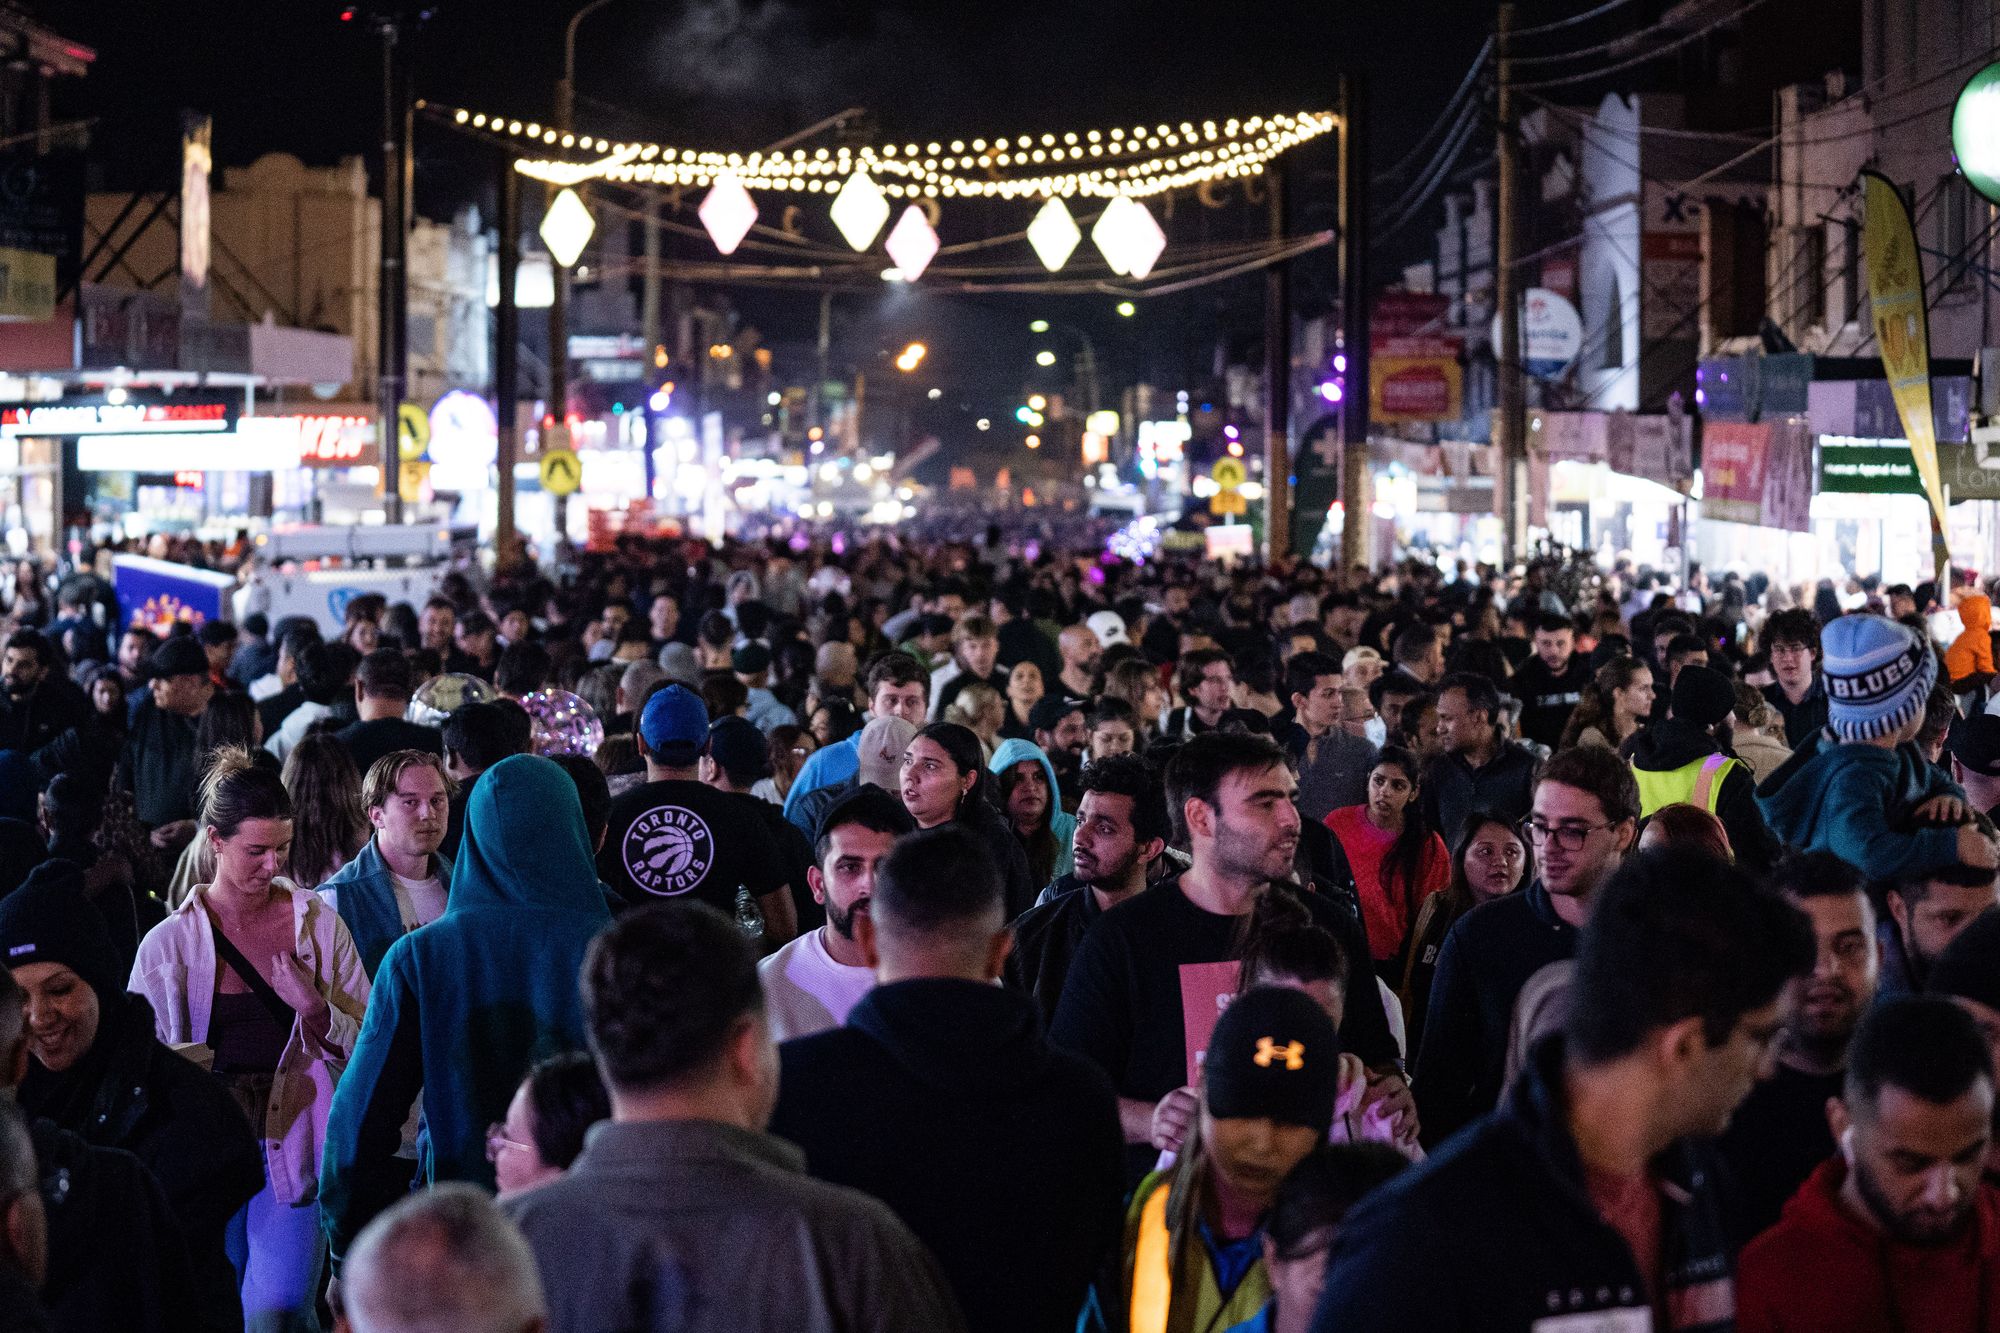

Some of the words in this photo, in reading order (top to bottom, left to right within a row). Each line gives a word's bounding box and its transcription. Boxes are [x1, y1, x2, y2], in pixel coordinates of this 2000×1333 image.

[1831, 653, 1914, 698] BLUES
[631, 810, 706, 842] TORONTO
[631, 859, 706, 891] RAPTORS
